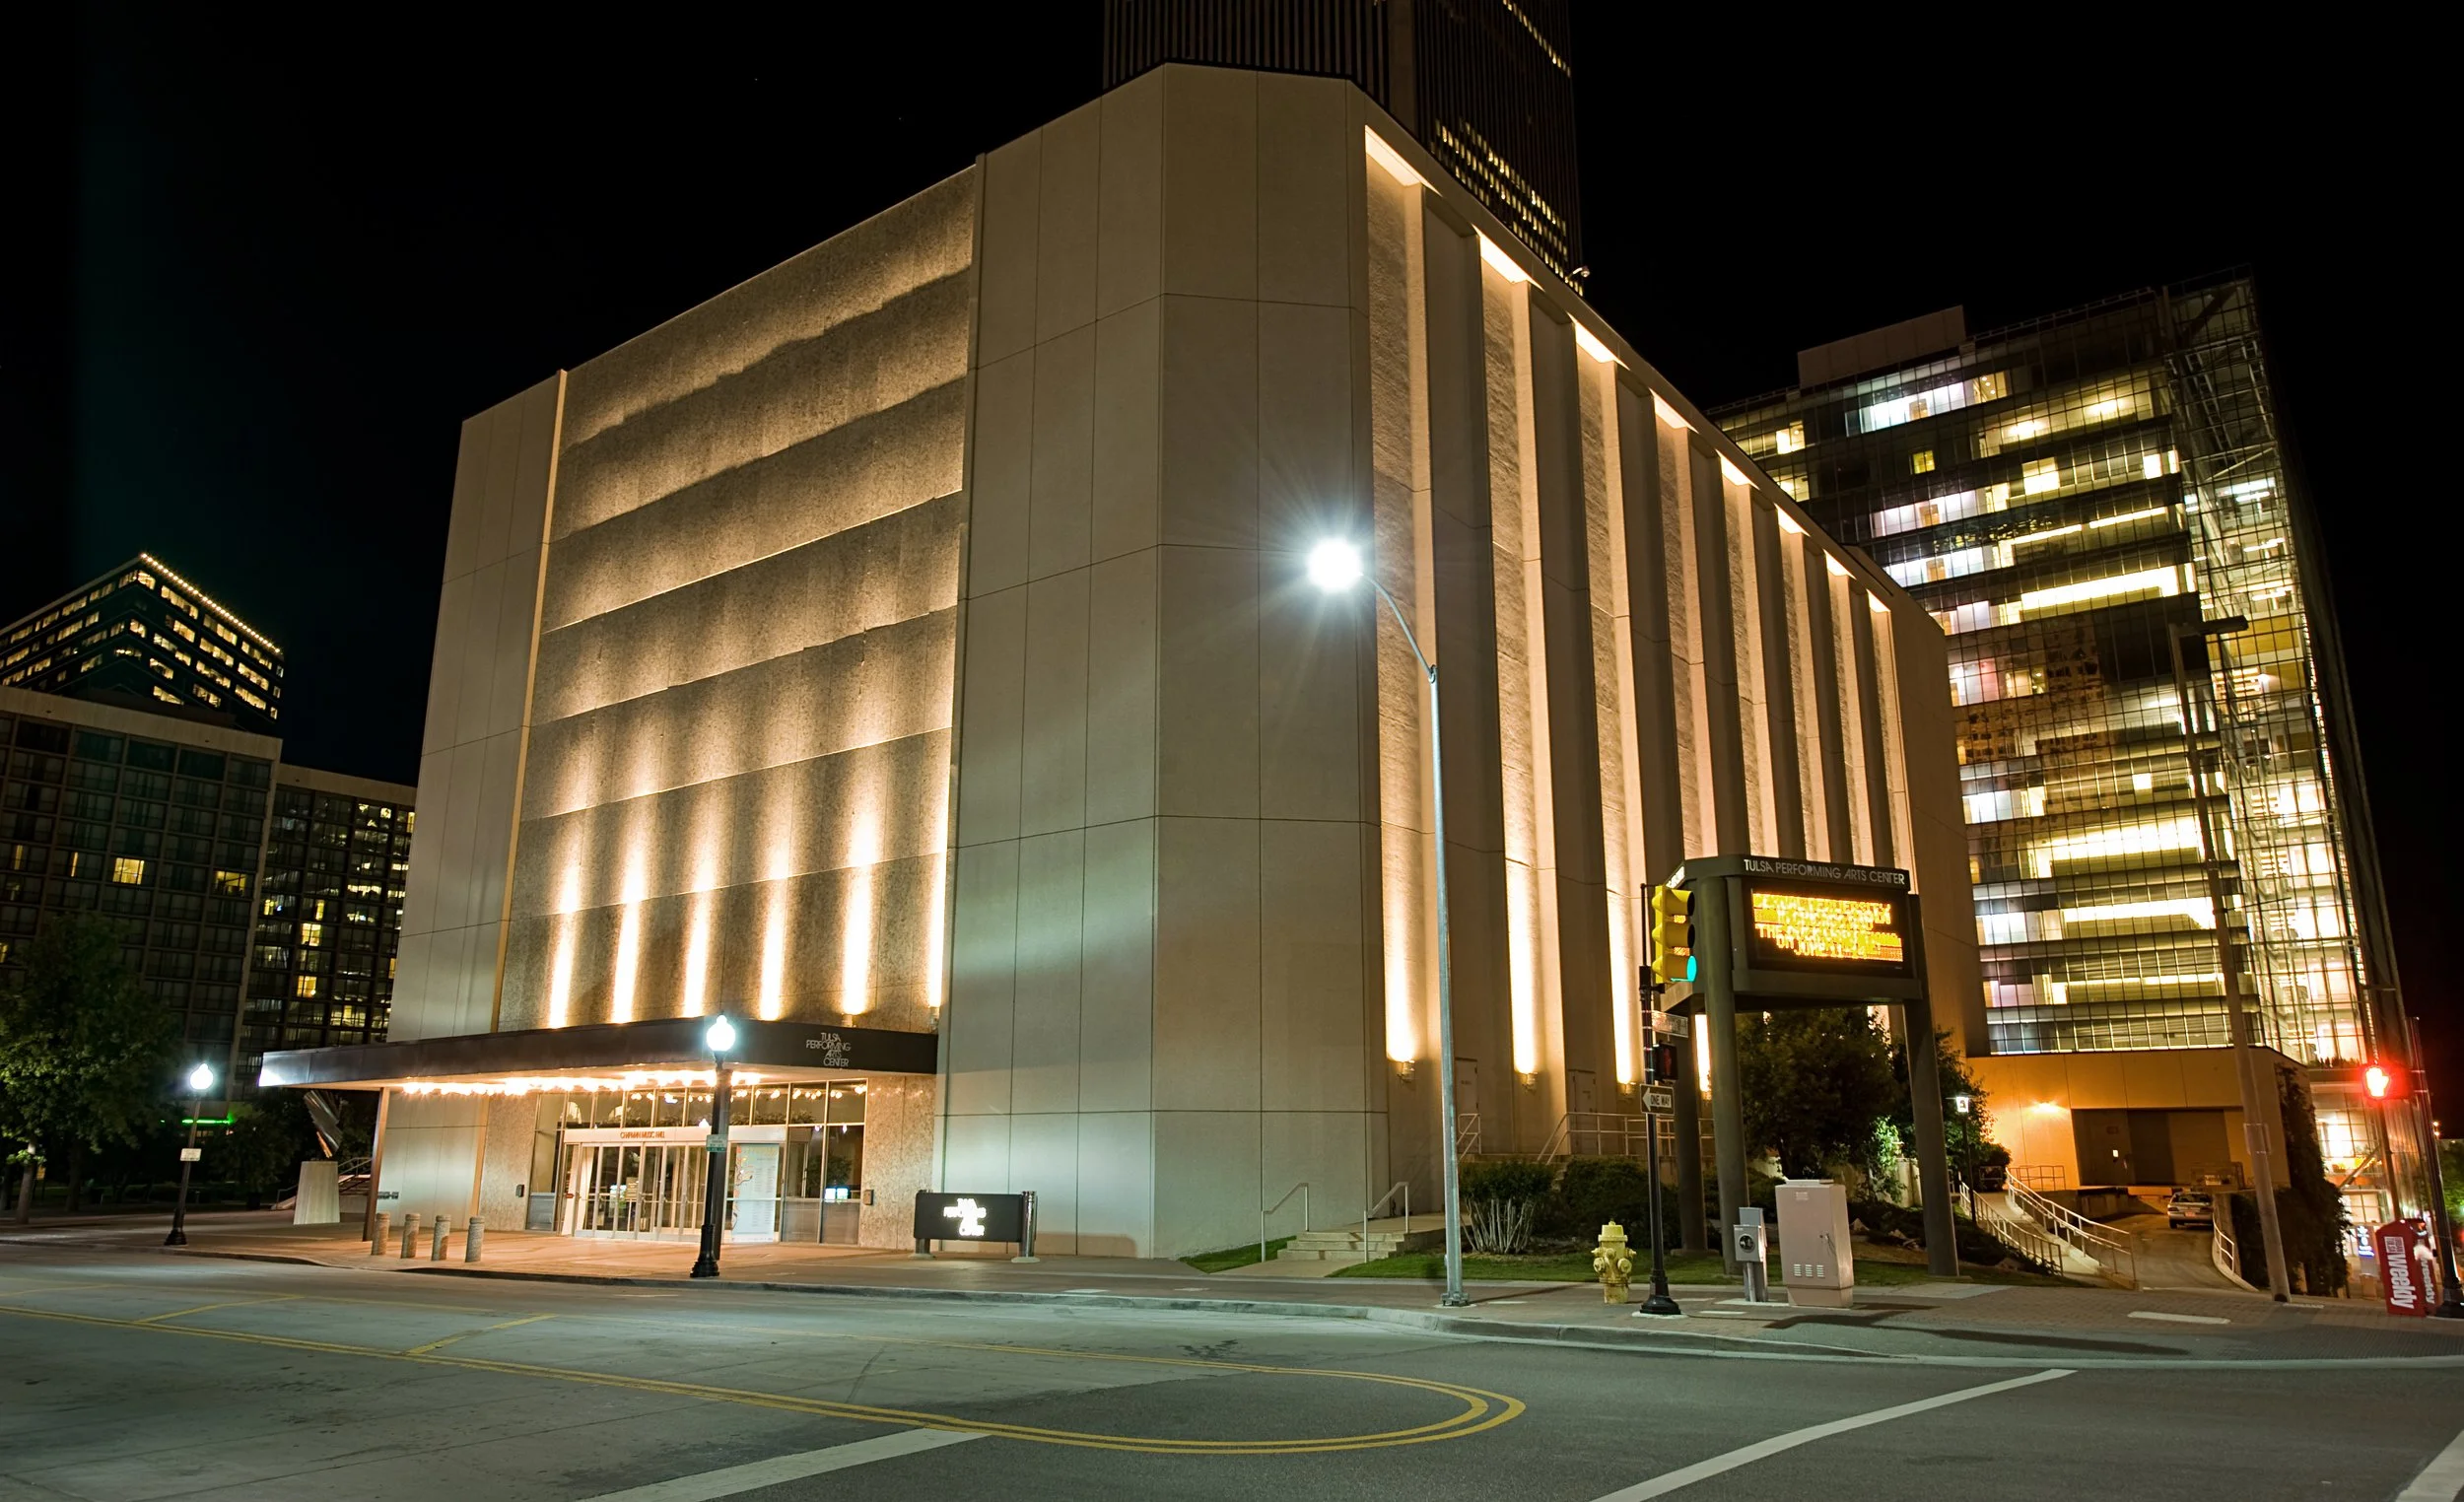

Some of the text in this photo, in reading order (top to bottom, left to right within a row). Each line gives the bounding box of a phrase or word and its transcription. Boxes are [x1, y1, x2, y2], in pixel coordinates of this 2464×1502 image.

[1744, 858, 1905, 885] TULSA PERFORMING ARTS CENTER
[820, 1032, 842, 1042] TULSA
[805, 1039, 852, 1052] PERFORMING
[825, 1050, 842, 1058] ARTS
[823, 1058, 850, 1067] CENTER
[1650, 1094, 1672, 1107] ONE WAY
[2387, 1253, 2418, 1309] weekly
